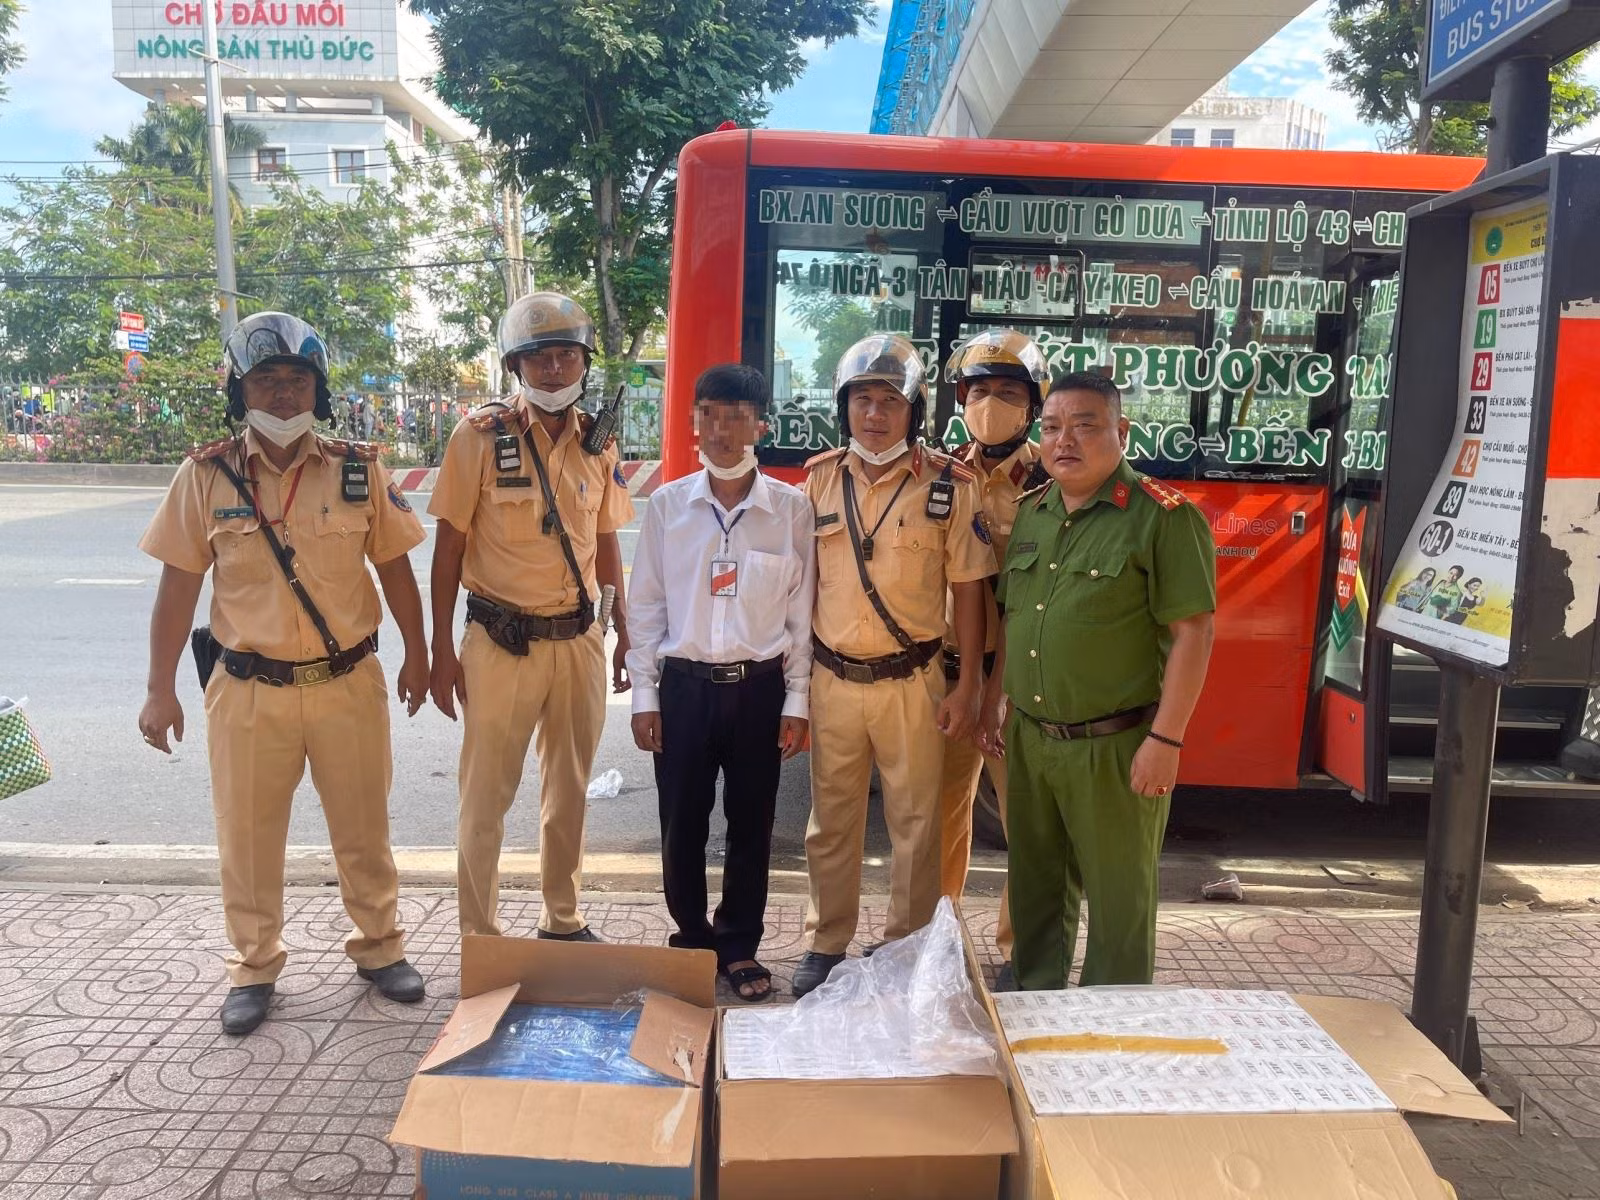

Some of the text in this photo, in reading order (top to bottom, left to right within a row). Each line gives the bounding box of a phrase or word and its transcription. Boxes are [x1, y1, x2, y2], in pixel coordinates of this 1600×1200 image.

[322, 35, 374, 60] ĐỨC
[1447, 10, 1484, 59] BUS
[759, 187, 1406, 252] BX.AN SƯƠNG CẦU VƯỢT GÒ DƯA TỈNH LỘ 43 CH
[831, 256, 881, 297] NGÃ
[918, 258, 968, 301] TÂN
[982, 259, 1032, 312] HẬU
[1110, 273, 1162, 308] KEO
[1190, 265, 1242, 310] CẦU
[1308, 280, 1347, 314] AN
[1484, 269, 1498, 301] 05
[1480, 314, 1494, 345] 19
[1111, 338, 1335, 398] PHƯƠNG
[1475, 357, 1489, 387] 29
[760, 393, 842, 450] ẾN
[1470, 401, 1484, 431] 33
[1226, 410, 1332, 467] BẾN
[1460, 444, 1477, 473] 42
[1441, 486, 1463, 514] 89
[1213, 512, 1278, 536] Lines
[1420, 523, 1452, 555] 60-1
[1457, 526, 1469, 538] BẾN
[1470, 532, 1478, 541] XE
[1215, 546, 1239, 557] ANH
[1338, 580, 1351, 598] Exit
[460, 1184, 492, 1196] LONG
[498, 1185, 518, 1197] SIZE
[525, 1187, 558, 1199] CLASS
[565, 1189, 572, 1199] A
